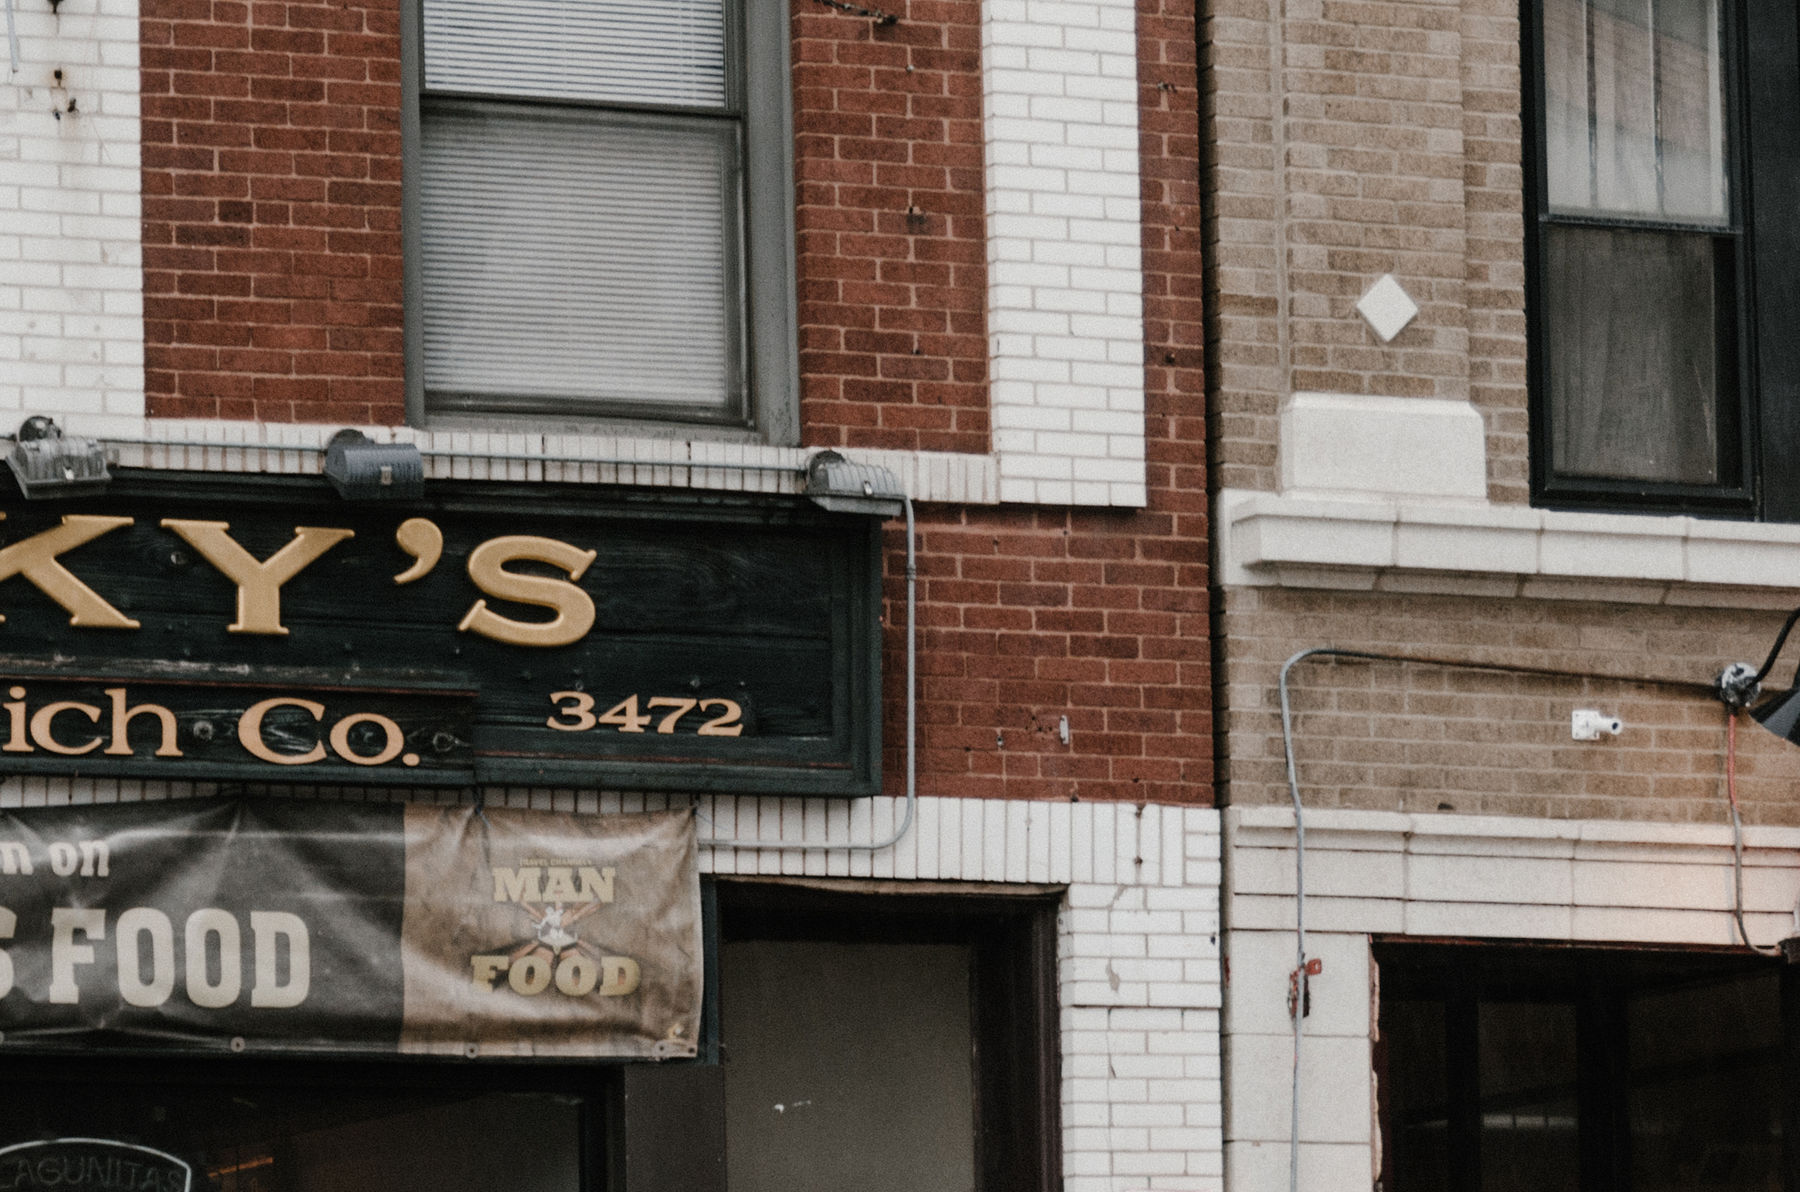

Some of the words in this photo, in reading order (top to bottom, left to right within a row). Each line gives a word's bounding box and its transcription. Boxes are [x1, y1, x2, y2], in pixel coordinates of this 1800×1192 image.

[236, 697, 421, 766] Co.
[545, 690, 745, 738] 3472
[48, 840, 111, 878] on
[492, 866, 616, 903] MAN
[48, 906, 311, 1009] FOOD
[469, 954, 642, 998] FOOD
